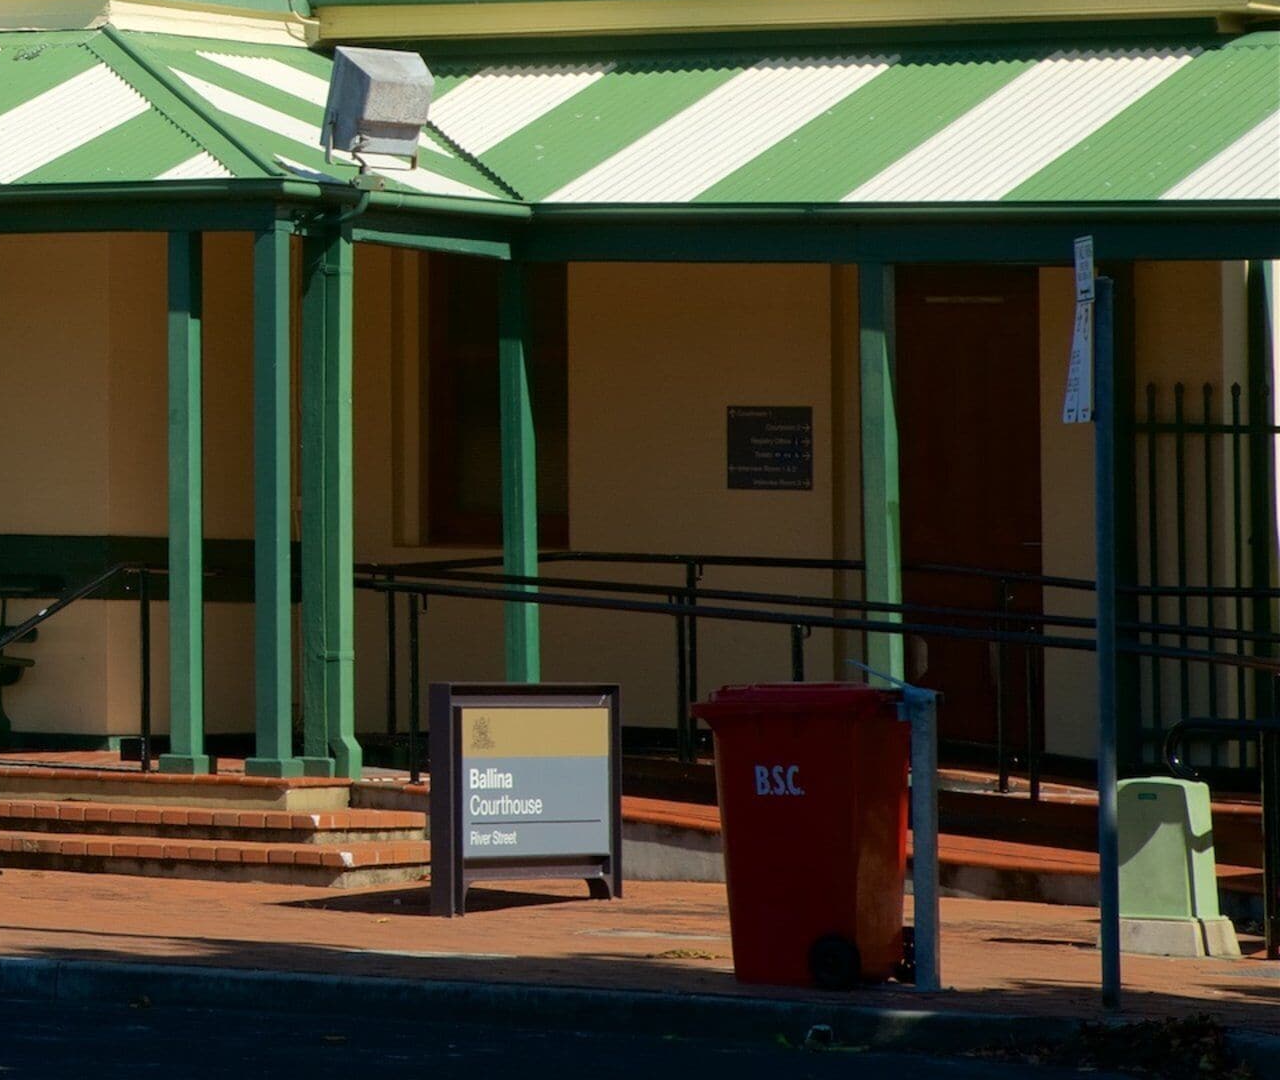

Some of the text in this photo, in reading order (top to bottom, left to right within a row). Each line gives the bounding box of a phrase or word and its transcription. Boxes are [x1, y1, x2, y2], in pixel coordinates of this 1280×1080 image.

[470, 768, 512, 789] Ballina
[755, 765, 805, 795] B.S.C.
[470, 794, 543, 816] Courthouse
[470, 830, 517, 846] River Street
